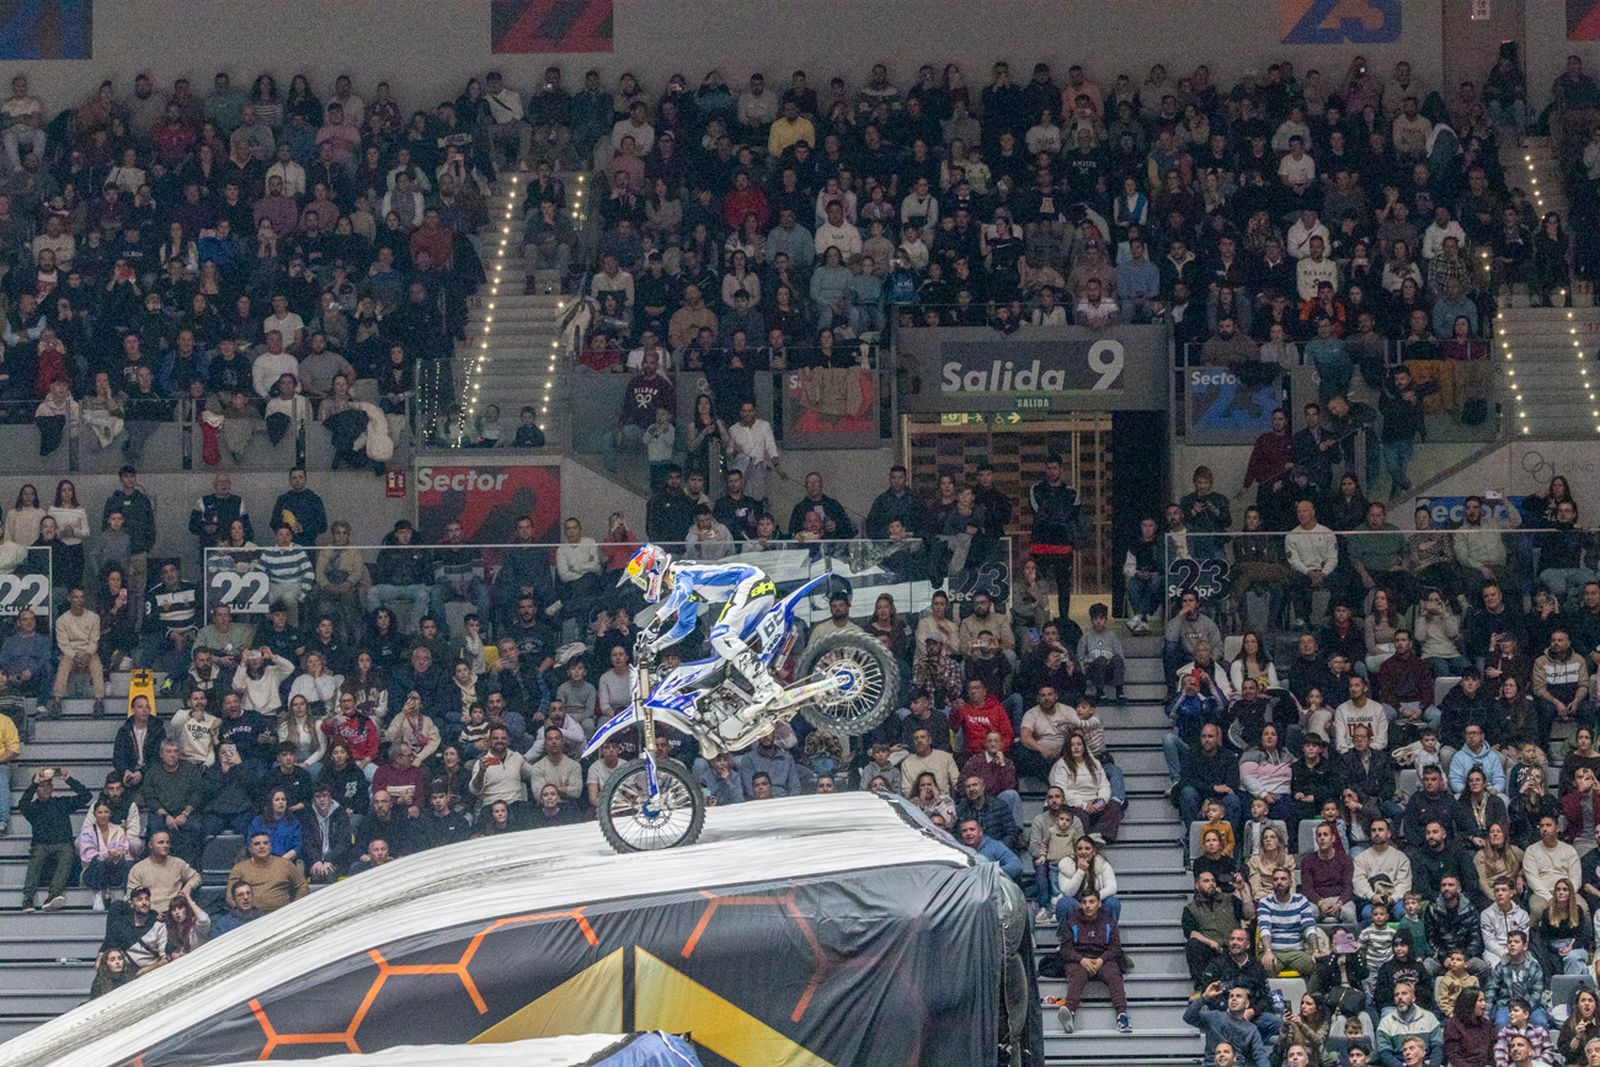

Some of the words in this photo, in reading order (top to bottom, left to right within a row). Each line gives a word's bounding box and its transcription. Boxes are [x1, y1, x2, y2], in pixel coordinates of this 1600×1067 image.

[941, 360, 1066, 391] Salida
[1087, 339, 1125, 391] 9
[1191, 370, 1241, 385] Secto
[1017, 399, 1049, 408] SALIDA
[416, 467, 508, 492] Sector
[0, 574, 49, 616] 22
[211, 572, 269, 614] 22
[1169, 557, 1231, 601] 23
